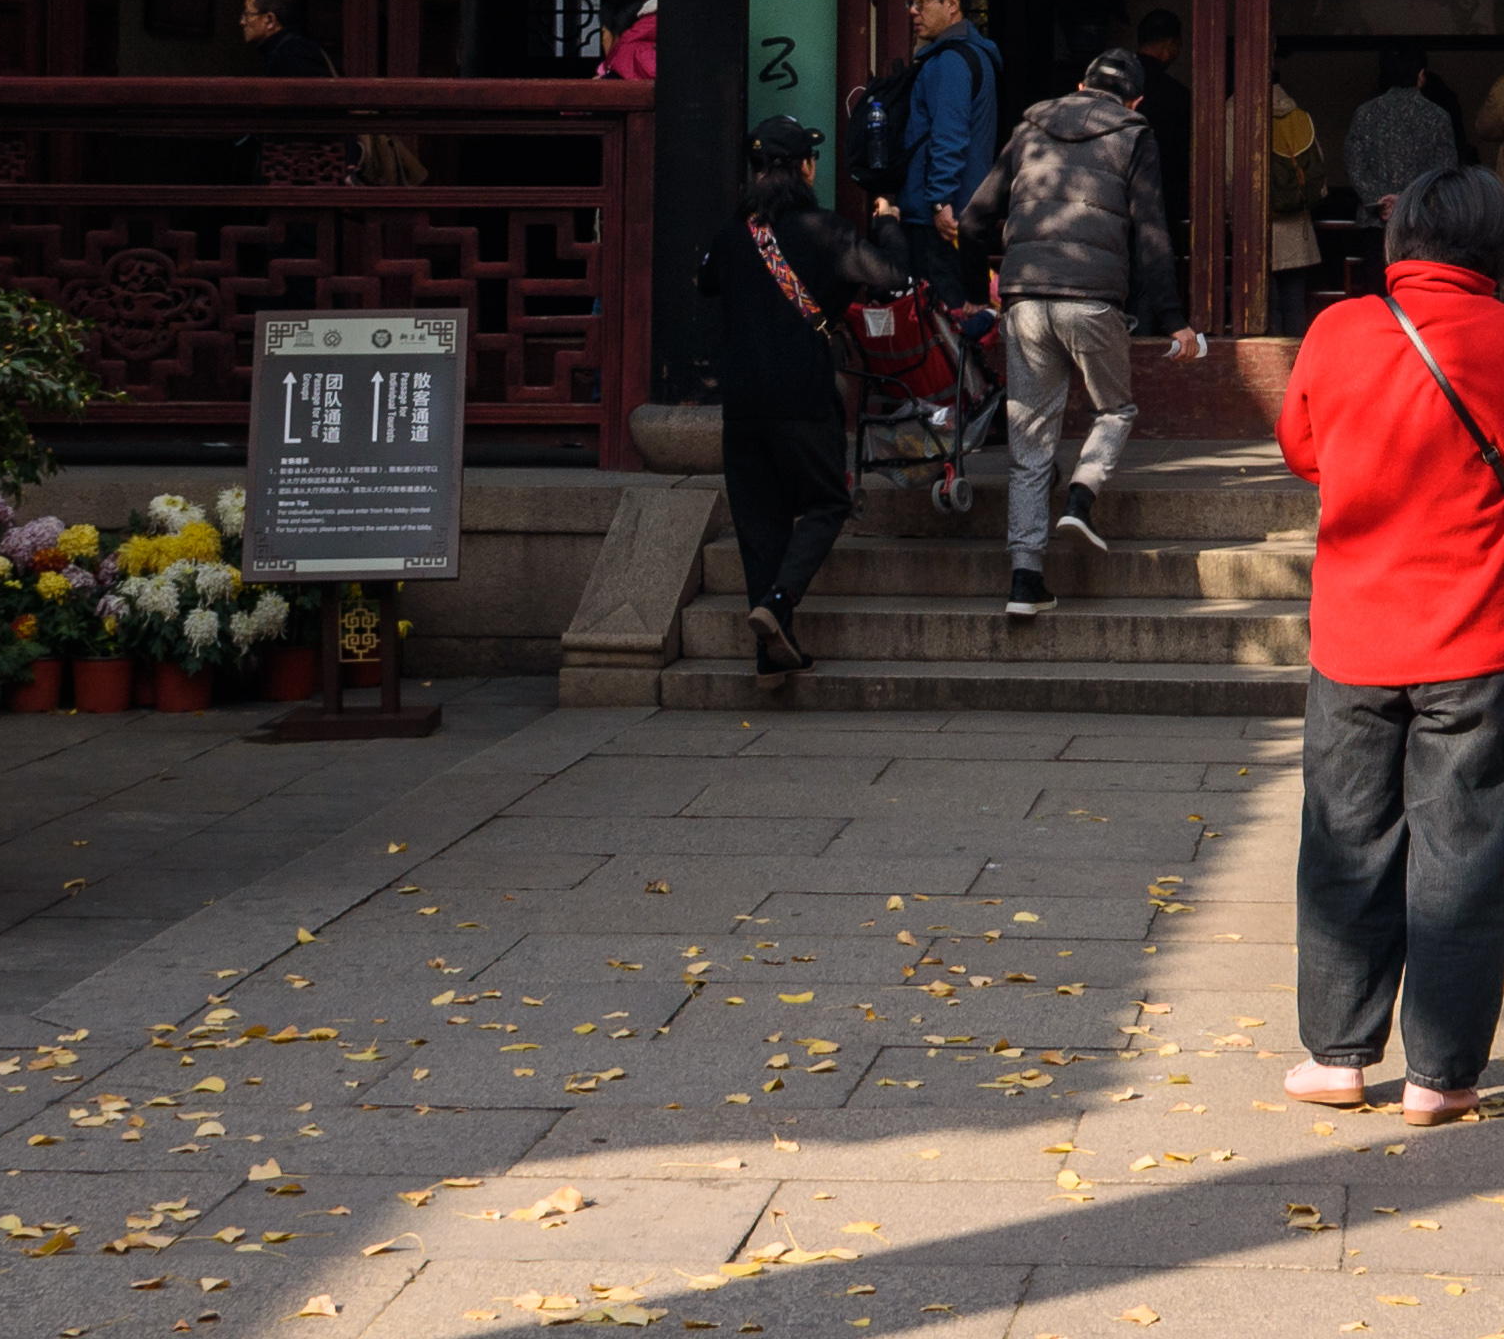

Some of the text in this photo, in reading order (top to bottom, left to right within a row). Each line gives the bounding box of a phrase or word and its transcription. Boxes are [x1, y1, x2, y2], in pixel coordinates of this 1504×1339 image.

[300, 373, 312, 400] Groups
[310, 373, 324, 438] Passage for Tour
[322, 373, 344, 444] 团队通道
[386, 372, 399, 443] Individual Tourists
[398, 372, 410, 417] Passage for
[410, 372, 432, 442] 散客通道
